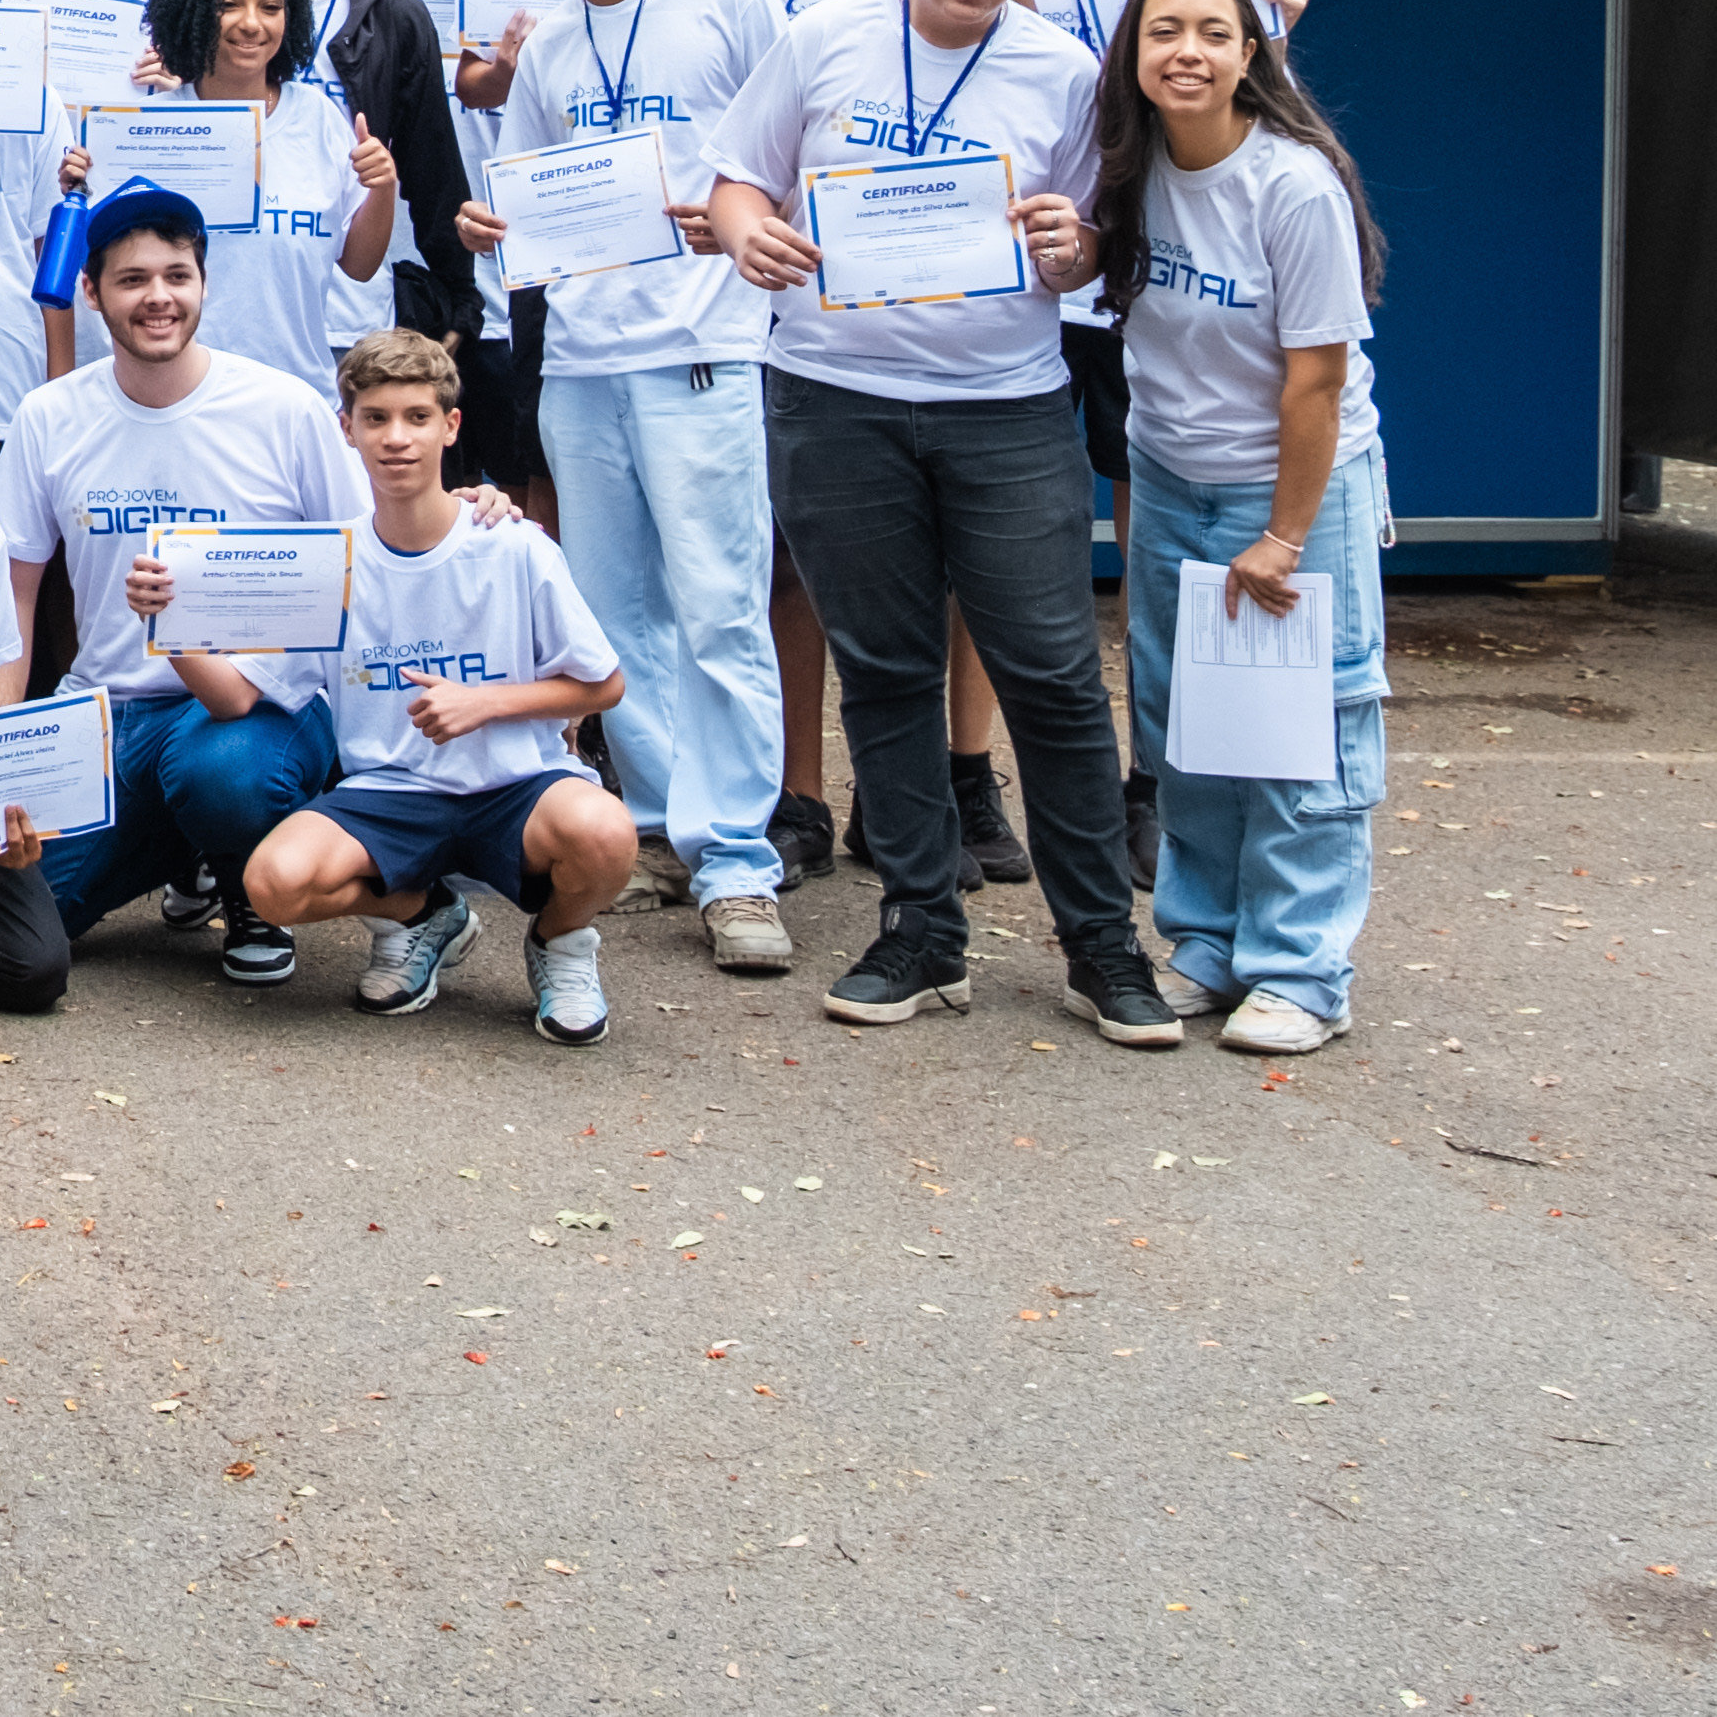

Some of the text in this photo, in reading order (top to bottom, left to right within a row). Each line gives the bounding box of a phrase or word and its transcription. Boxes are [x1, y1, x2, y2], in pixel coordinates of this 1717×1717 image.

[52, 7, 117, 22] RTIFICADO
[567, 95, 692, 128] DIGTAL
[128, 126, 212, 135] CERTIFICADO
[845, 116, 992, 157] DIGT
[531, 158, 613, 183] CERTIFICADO
[862, 181, 957, 200] CERTIFICADO
[1152, 237, 1192, 262] JOVEM
[1148, 255, 1258, 308] GITAL
[87, 488, 178, 503] PRÓ-JOVEM
[205, 550, 298, 561] CERTIFICADO
[362, 640, 444, 660] PRÓJOVEM
